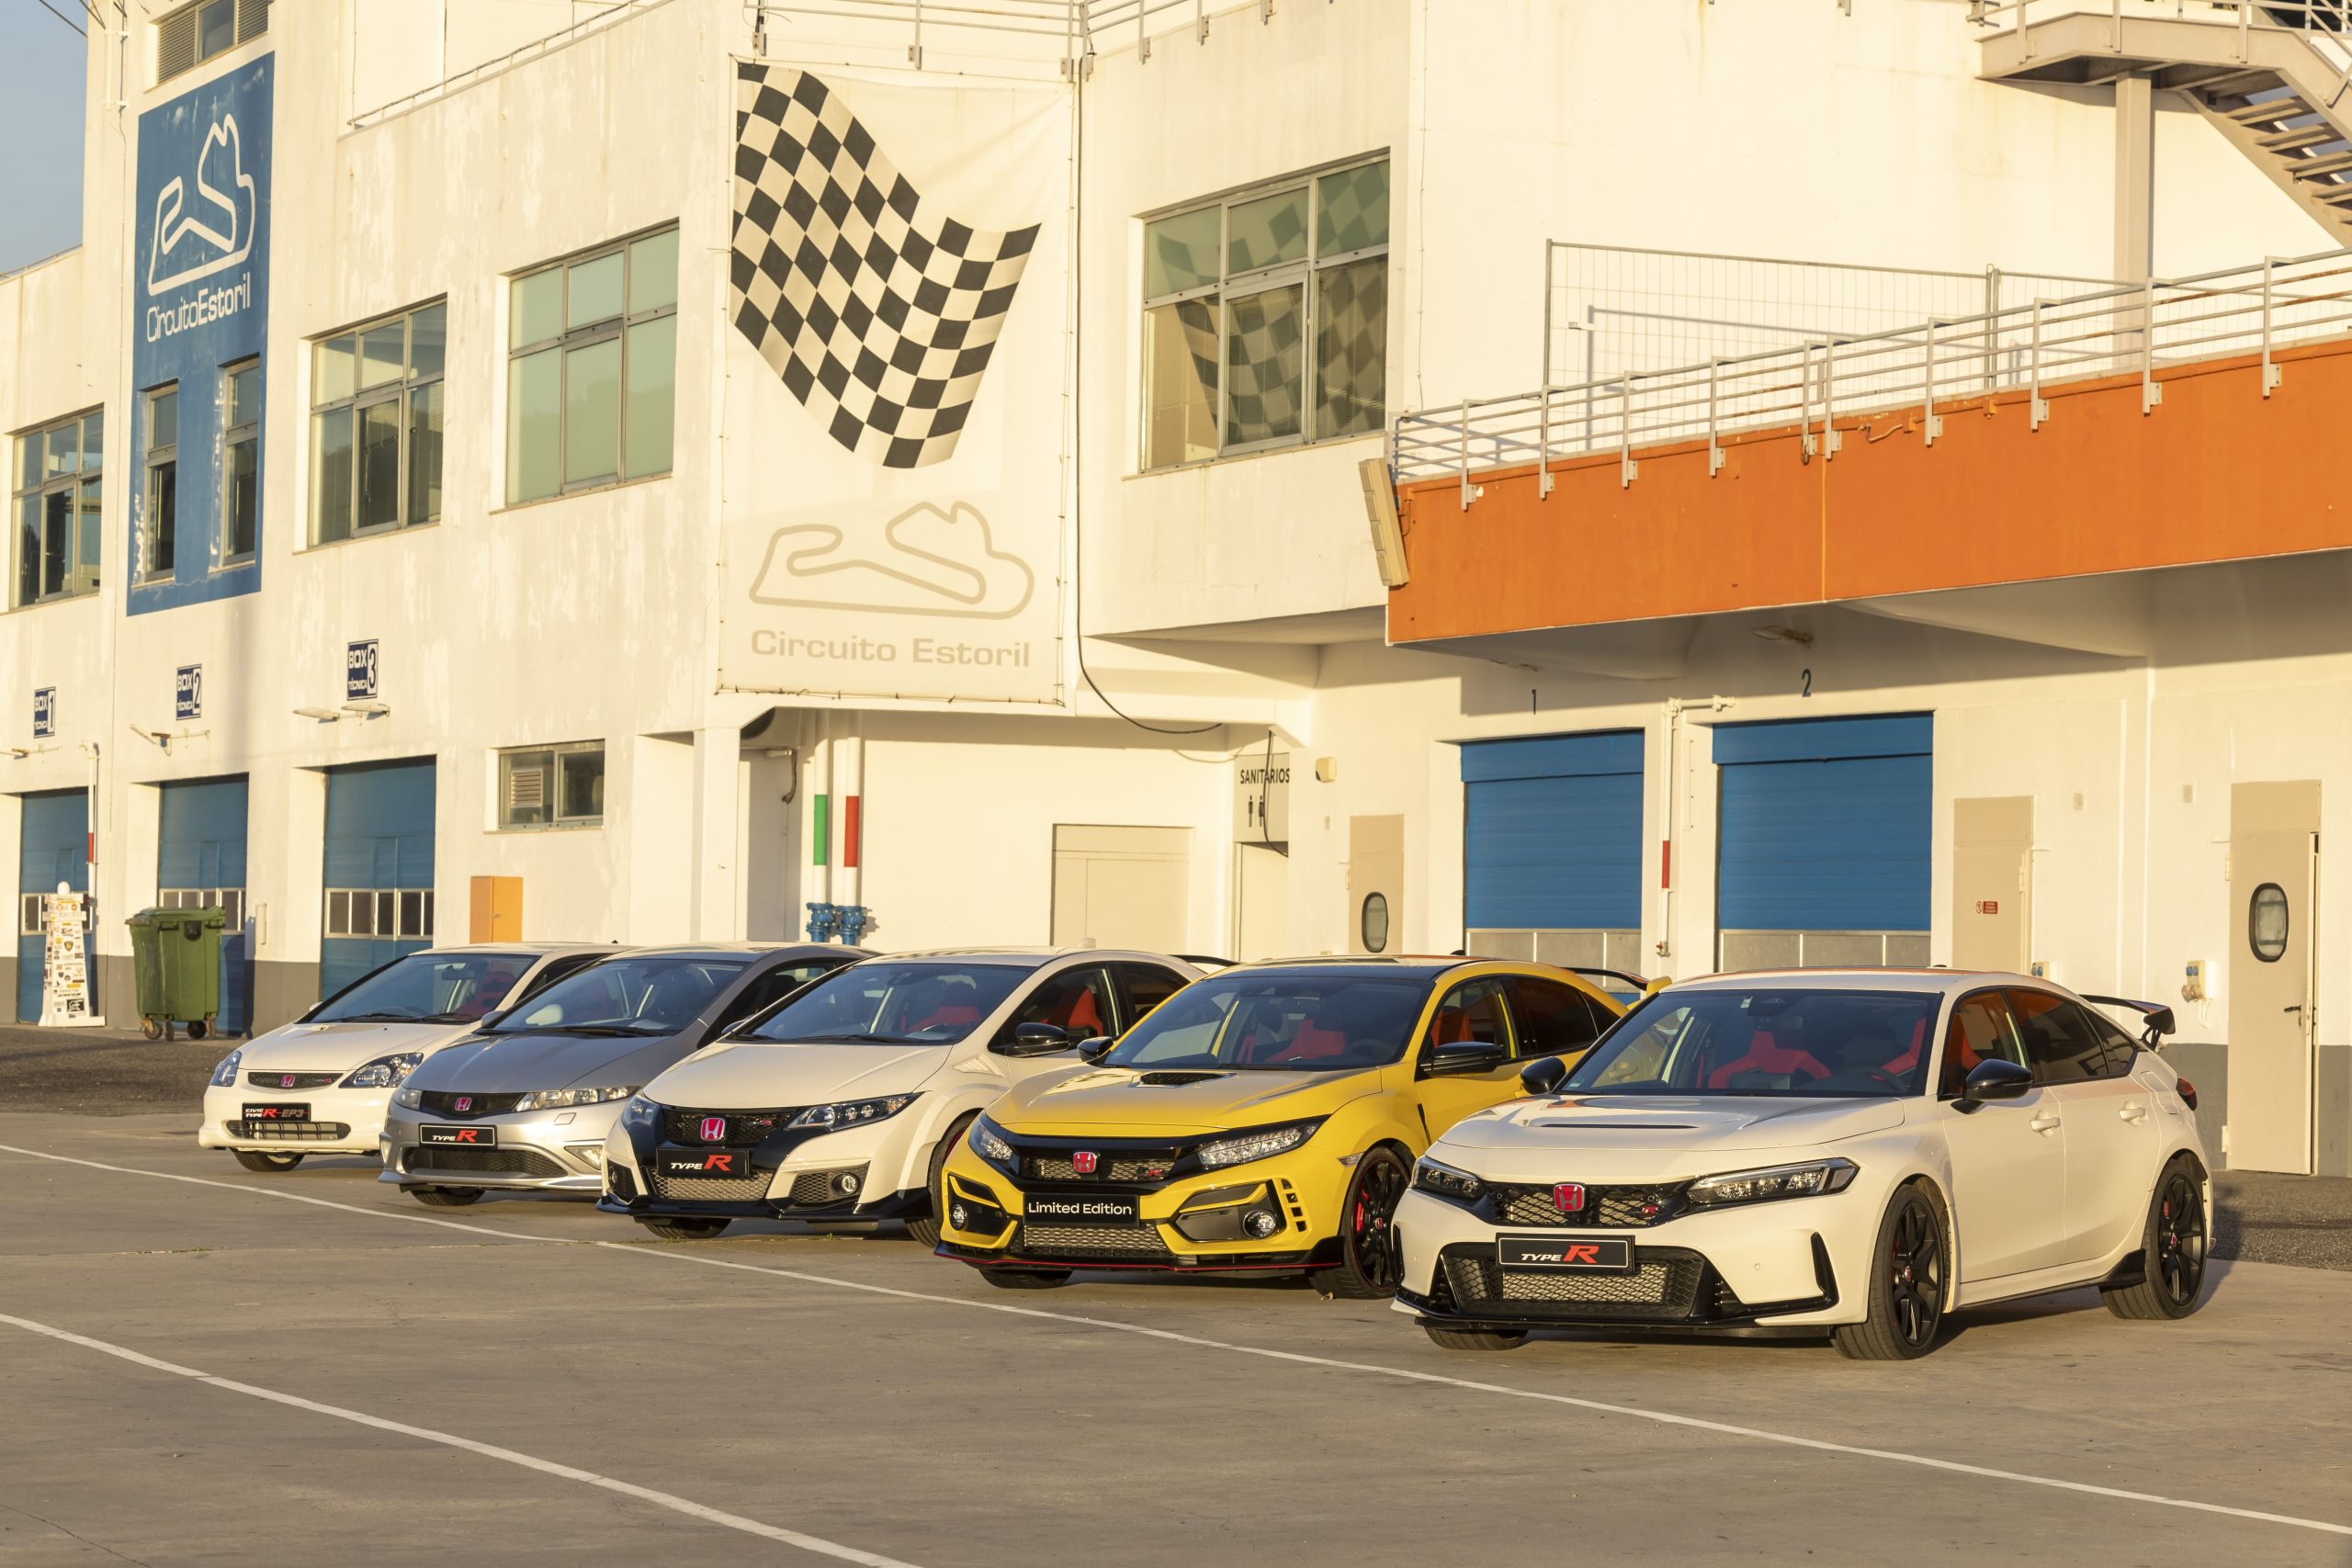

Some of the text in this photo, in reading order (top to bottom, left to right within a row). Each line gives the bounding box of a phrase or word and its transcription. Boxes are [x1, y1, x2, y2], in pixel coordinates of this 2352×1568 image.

[751, 629, 1030, 668] Circuito Estoril
[348, 648, 376, 689] BOX 3
[177, 672, 200, 708] BOX 2
[1802, 668, 1811, 697] 2
[35, 694, 54, 728] BOX 1
[1532, 689, 1537, 715] 1
[1240, 768, 1290, 784] SANITARIOS
[262, 1108, 277, 1118] R
[281, 1109, 304, 1118] EP3
[455, 1130, 478, 1143] R
[670, 1155, 732, 1172] TYPE R
[1028, 1201, 1133, 1215] Limited Edition
[1521, 1245, 1600, 1264] TYPE R
